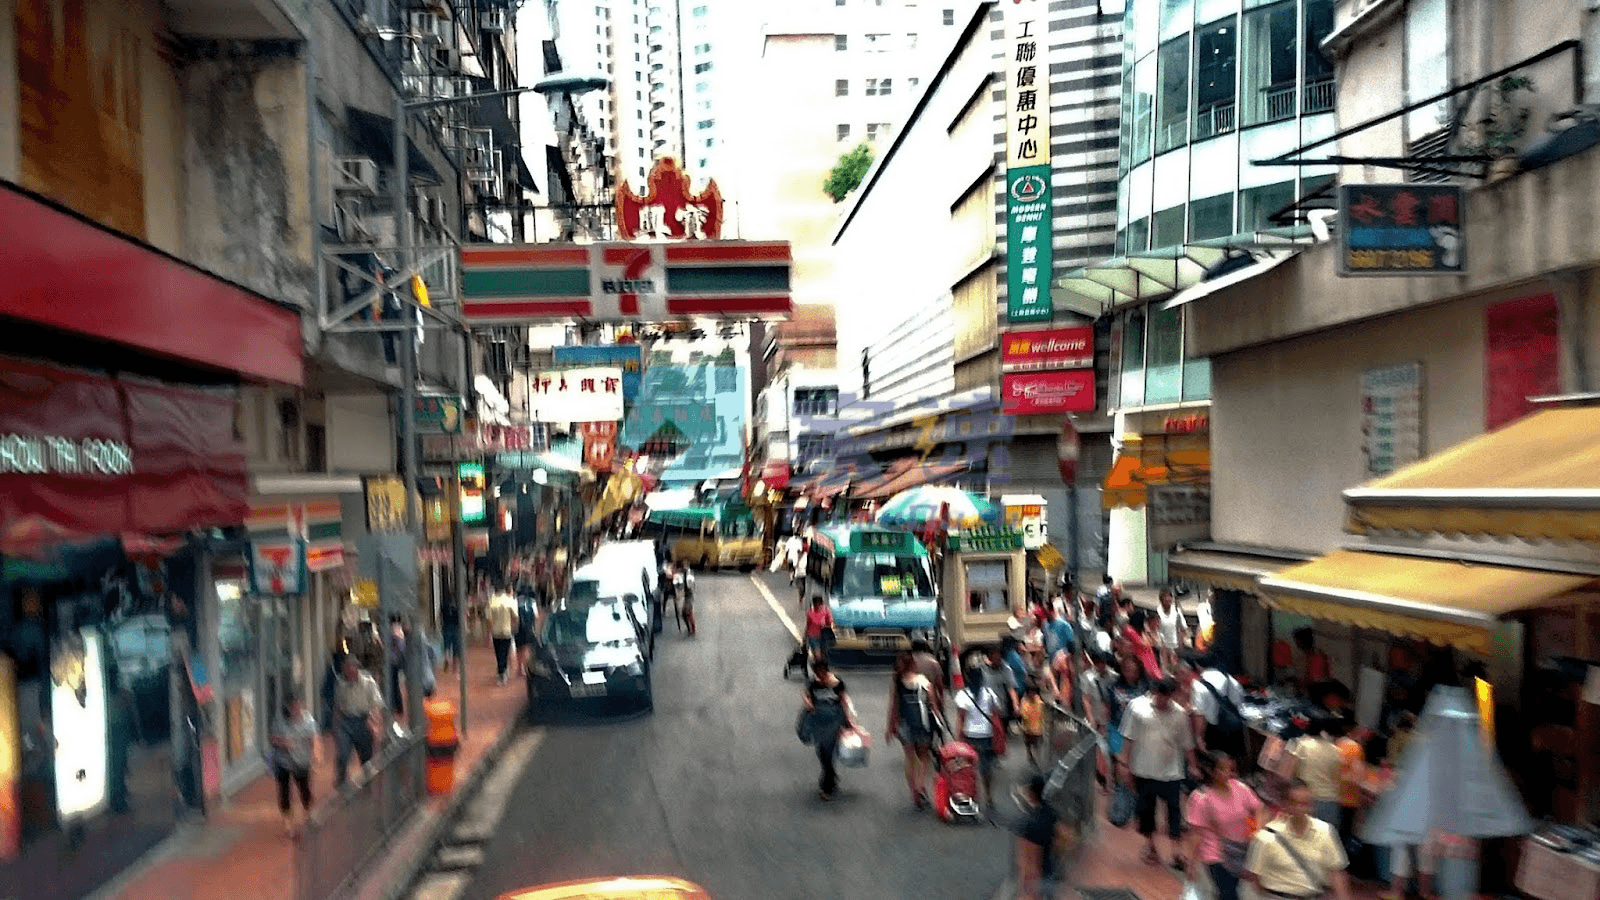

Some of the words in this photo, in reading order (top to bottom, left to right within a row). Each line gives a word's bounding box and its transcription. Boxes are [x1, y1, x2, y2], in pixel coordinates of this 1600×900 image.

[1016, 20, 1037, 159] 工聯優惠中心
[1031, 337, 1086, 353] wellcome
